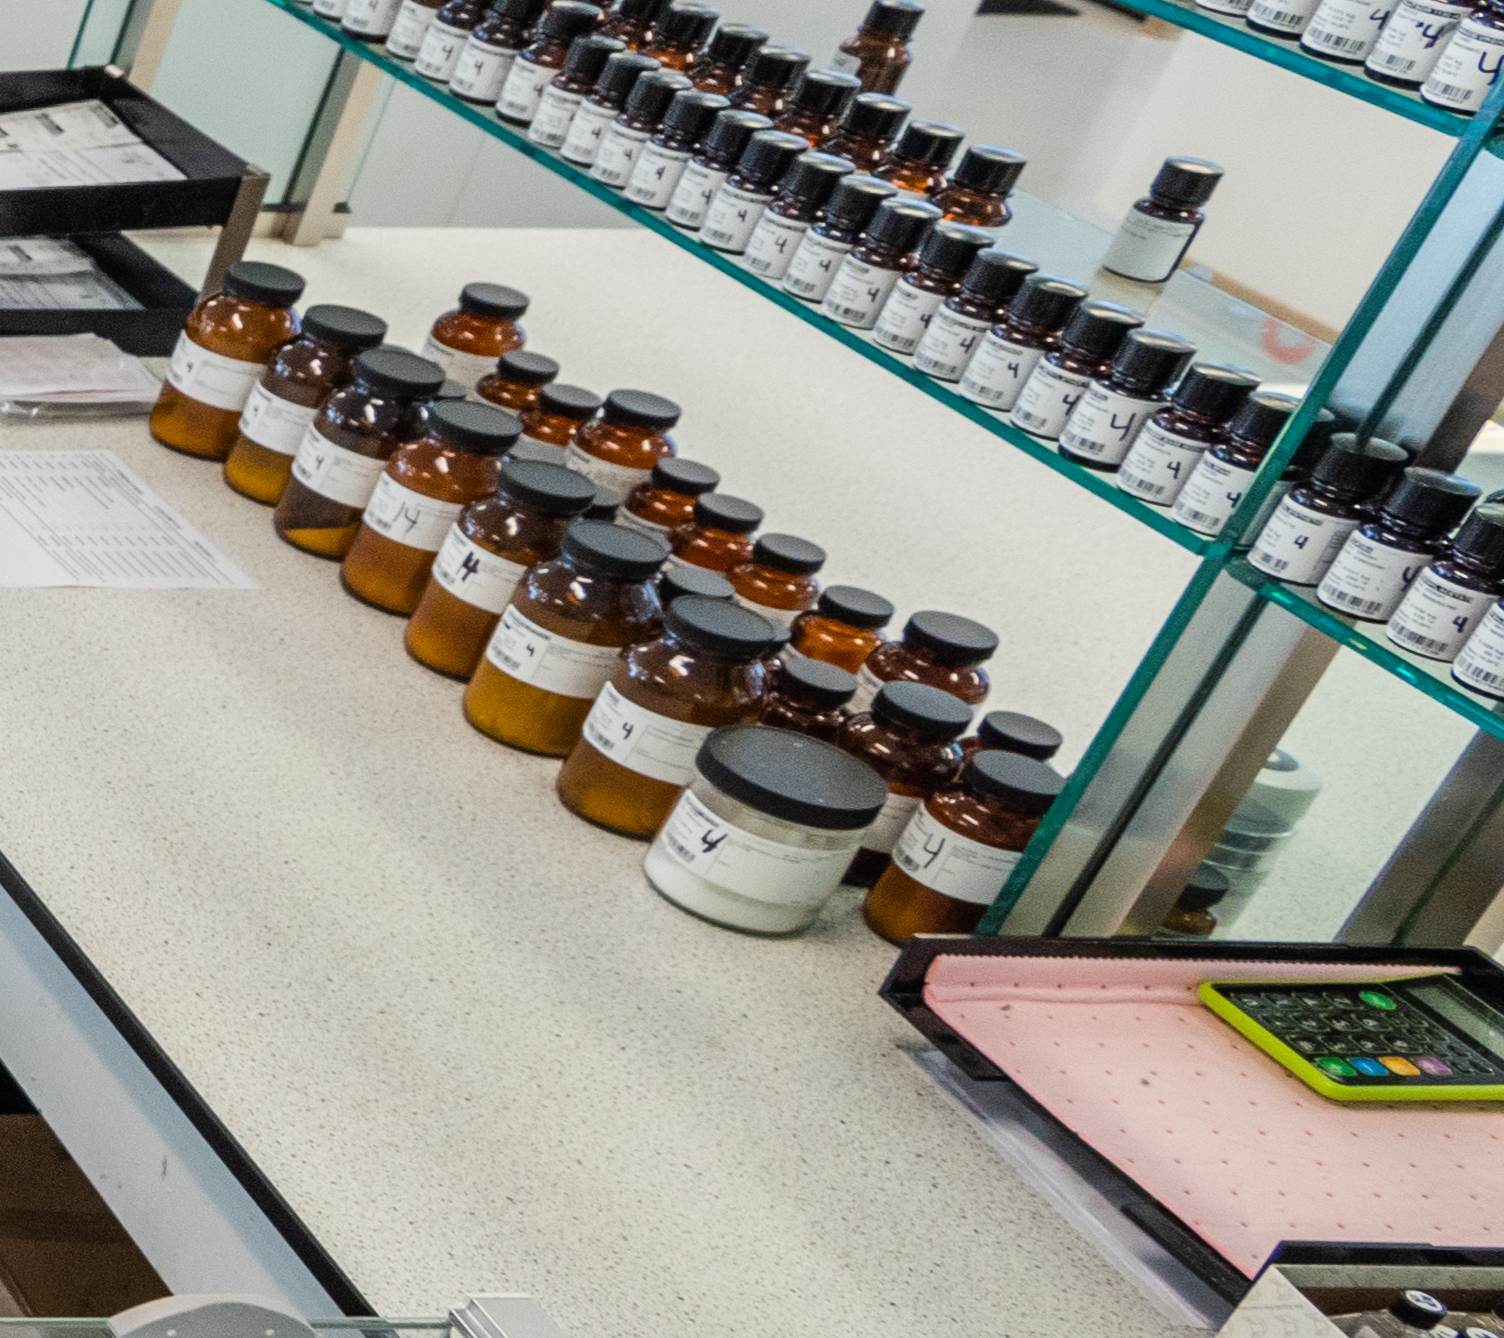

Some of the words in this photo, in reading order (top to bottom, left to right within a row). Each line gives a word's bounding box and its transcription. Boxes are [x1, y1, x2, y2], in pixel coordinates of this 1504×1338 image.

[1110, 412, 1136, 440] 4
[1167, 460, 1182, 480] 4
[1293, 535, 1309, 550] 4
[1452, 616, 1468, 633] 4
[525, 642, 535, 657] 4
[622, 722, 635, 739] 4
[701, 829, 729, 855] 4
[922, 837, 946, 869] 4
